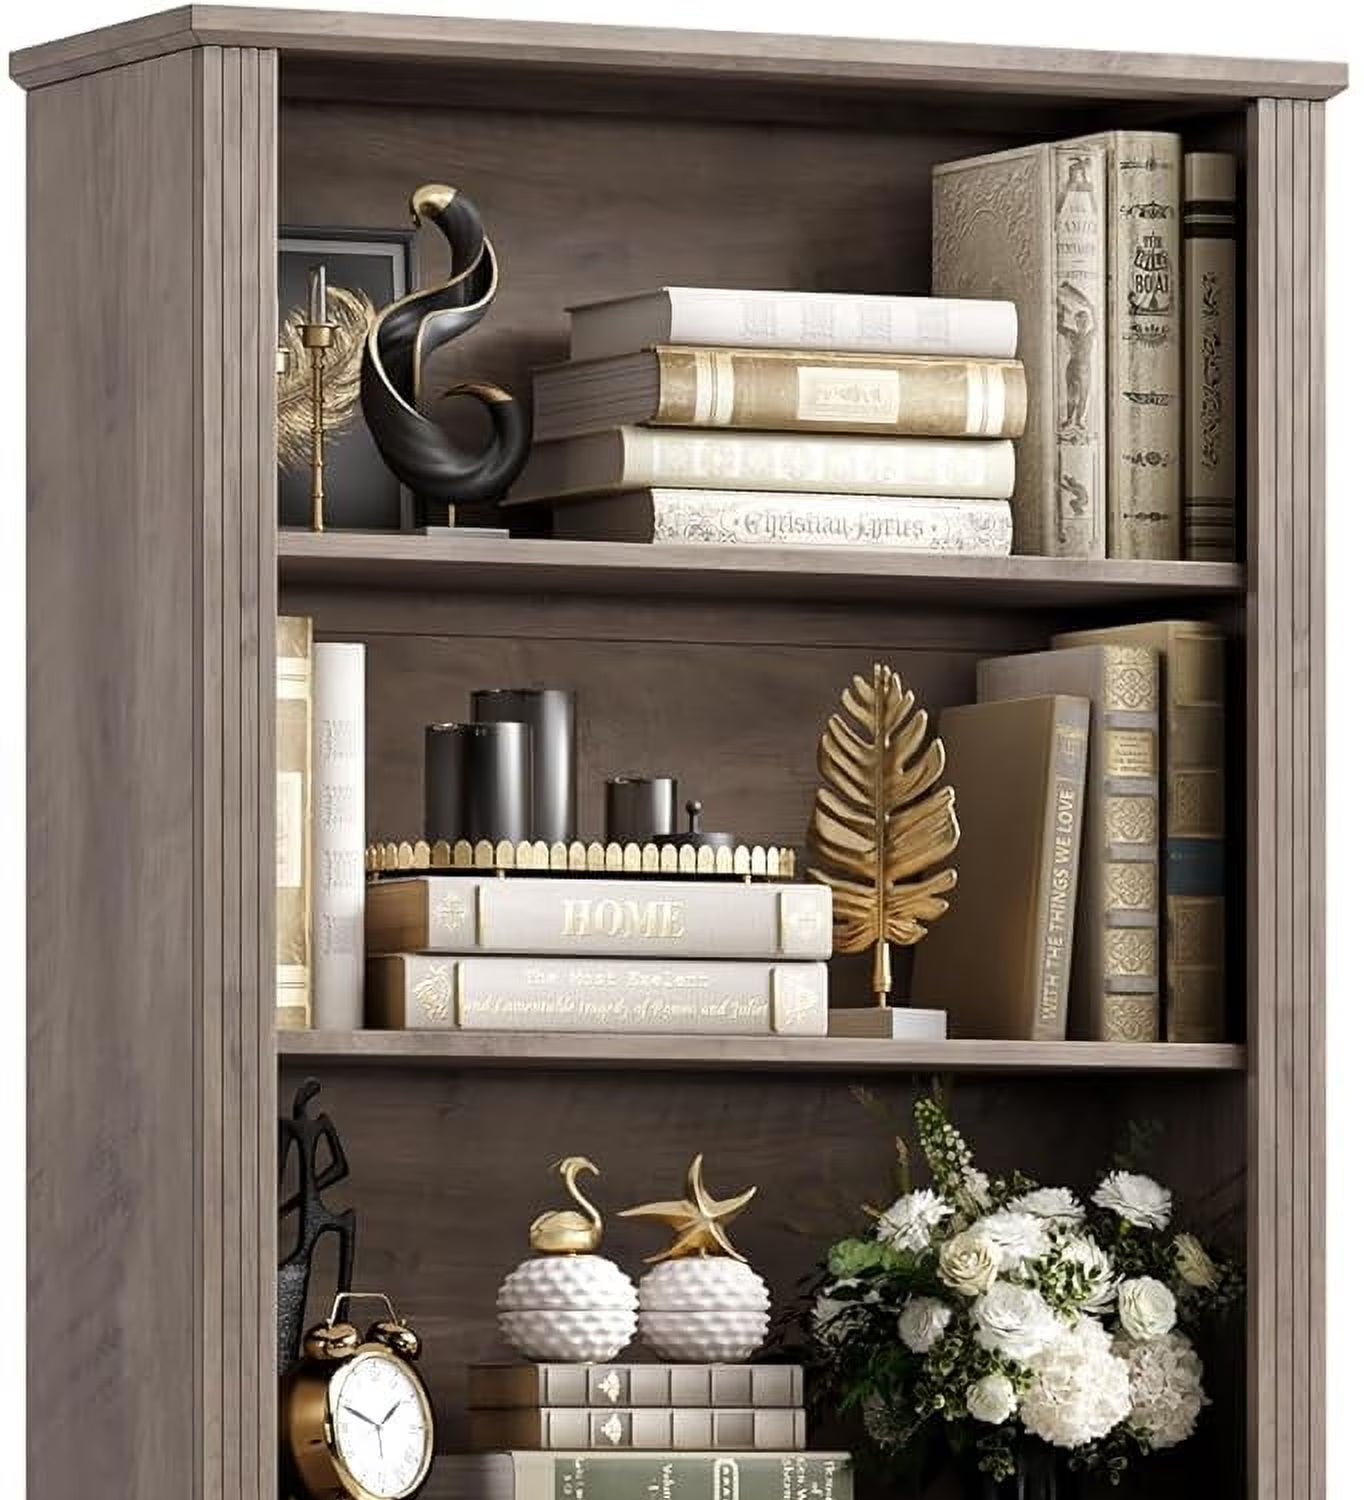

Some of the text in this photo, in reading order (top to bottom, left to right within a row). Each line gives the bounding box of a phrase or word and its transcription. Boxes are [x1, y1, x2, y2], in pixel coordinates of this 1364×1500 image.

[1056, 788, 1076, 834] LOVE
[1054, 835, 1072, 865] WE
[560, 898, 688, 938] HOME
[1049, 868, 1070, 934] THINGS
[1047, 936, 1064, 969] THE
